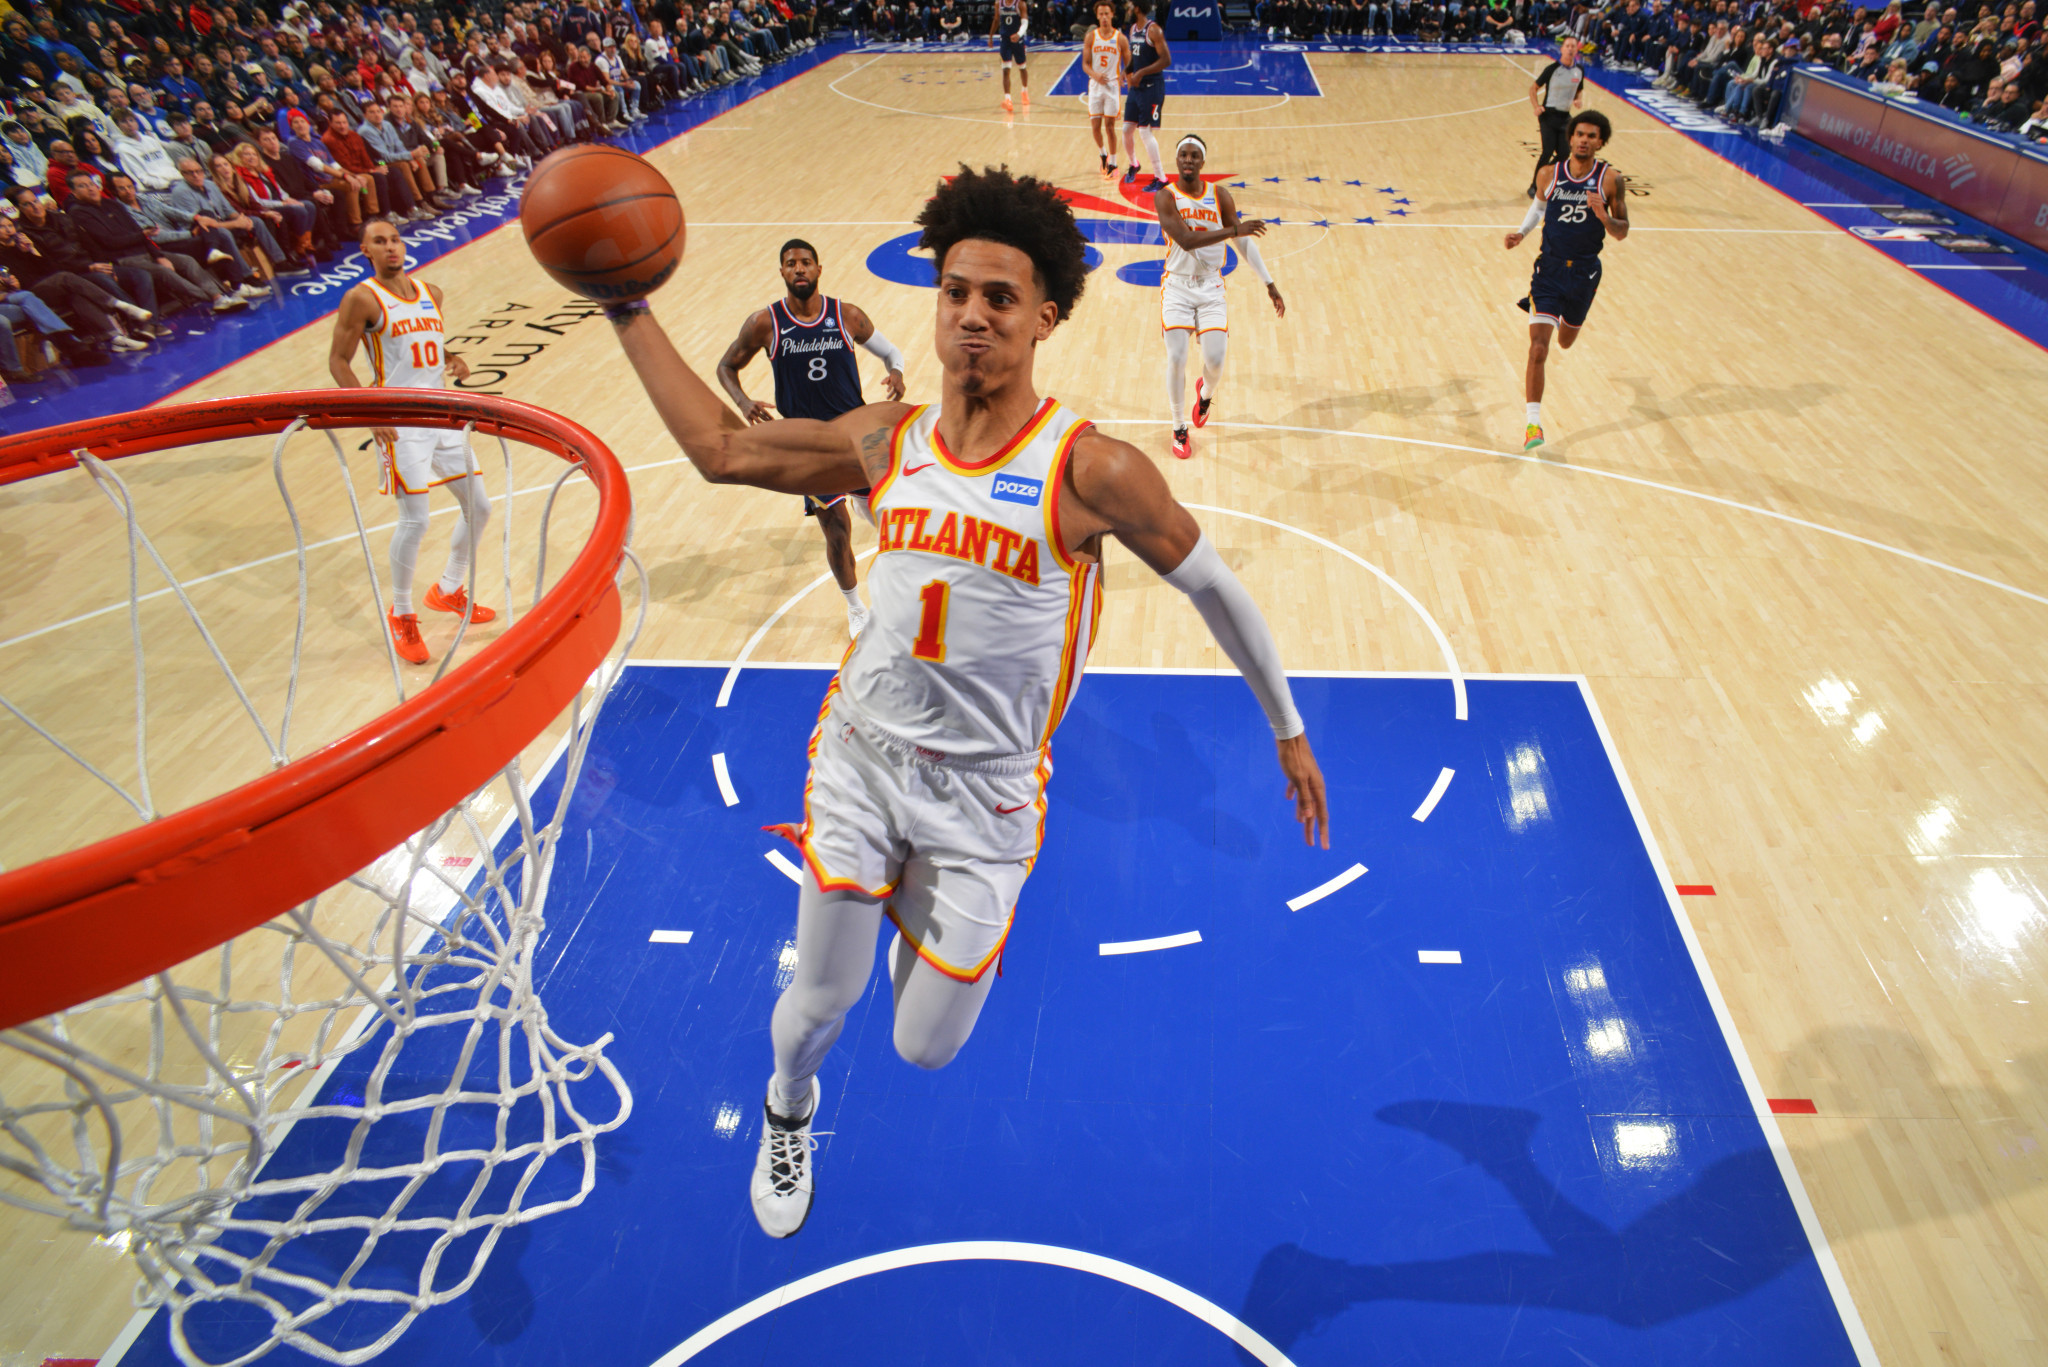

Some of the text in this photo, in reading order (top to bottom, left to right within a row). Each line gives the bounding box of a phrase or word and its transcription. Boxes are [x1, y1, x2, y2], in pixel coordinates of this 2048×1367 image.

[1005, 16, 1013, 25] 0
[1174, 7, 1212, 18] KIA
[615, 24, 630, 38] 77
[1093, 45, 1118, 55] ATLANTA
[1132, 44, 1140, 56] 21
[1319, 44, 1541, 54] crypto.com
[1100, 56, 1108, 67] 5
[1819, 112, 1854, 141] BANK
[1853, 127, 1872, 148] OF
[1870, 135, 1937, 179] AMERICA
[1179, 207, 1219, 224] TLANTA
[1558, 204, 1588, 223] 25
[410, 340, 440, 369] 10
[781, 336, 844, 356] Philadelphia
[808, 357, 828, 381] 8
[994, 479, 1039, 498] paze
[878, 507, 1042, 587] ATLANTA
[911, 579, 951, 664] 1
